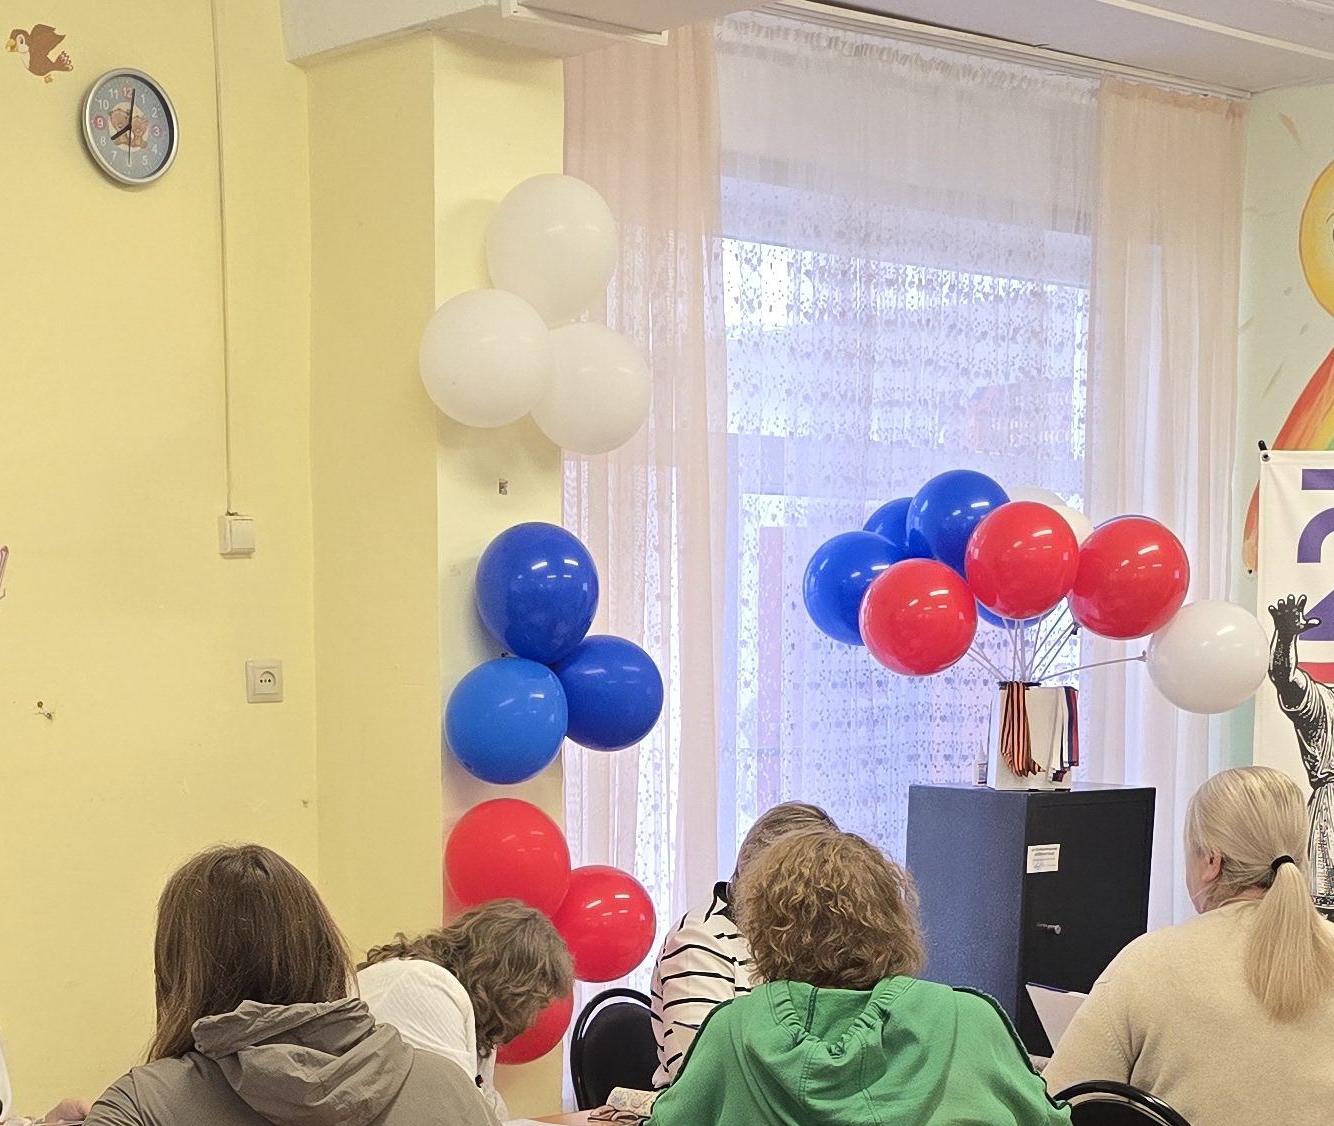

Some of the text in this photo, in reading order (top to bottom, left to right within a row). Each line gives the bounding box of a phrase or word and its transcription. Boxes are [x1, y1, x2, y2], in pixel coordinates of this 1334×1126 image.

[108, 88, 119, 99] 11
[123, 86, 133, 98] 12
[98, 99, 109, 110] 10
[140, 94, 146, 104] 1
[151, 107, 158, 118] 2
[97, 117, 104, 128] 9
[153, 126, 160, 137] 3
[100, 136, 106, 146] 8
[151, 144, 158, 154] 4
[111, 151, 117, 160] 7
[142, 155, 148, 166] 5
